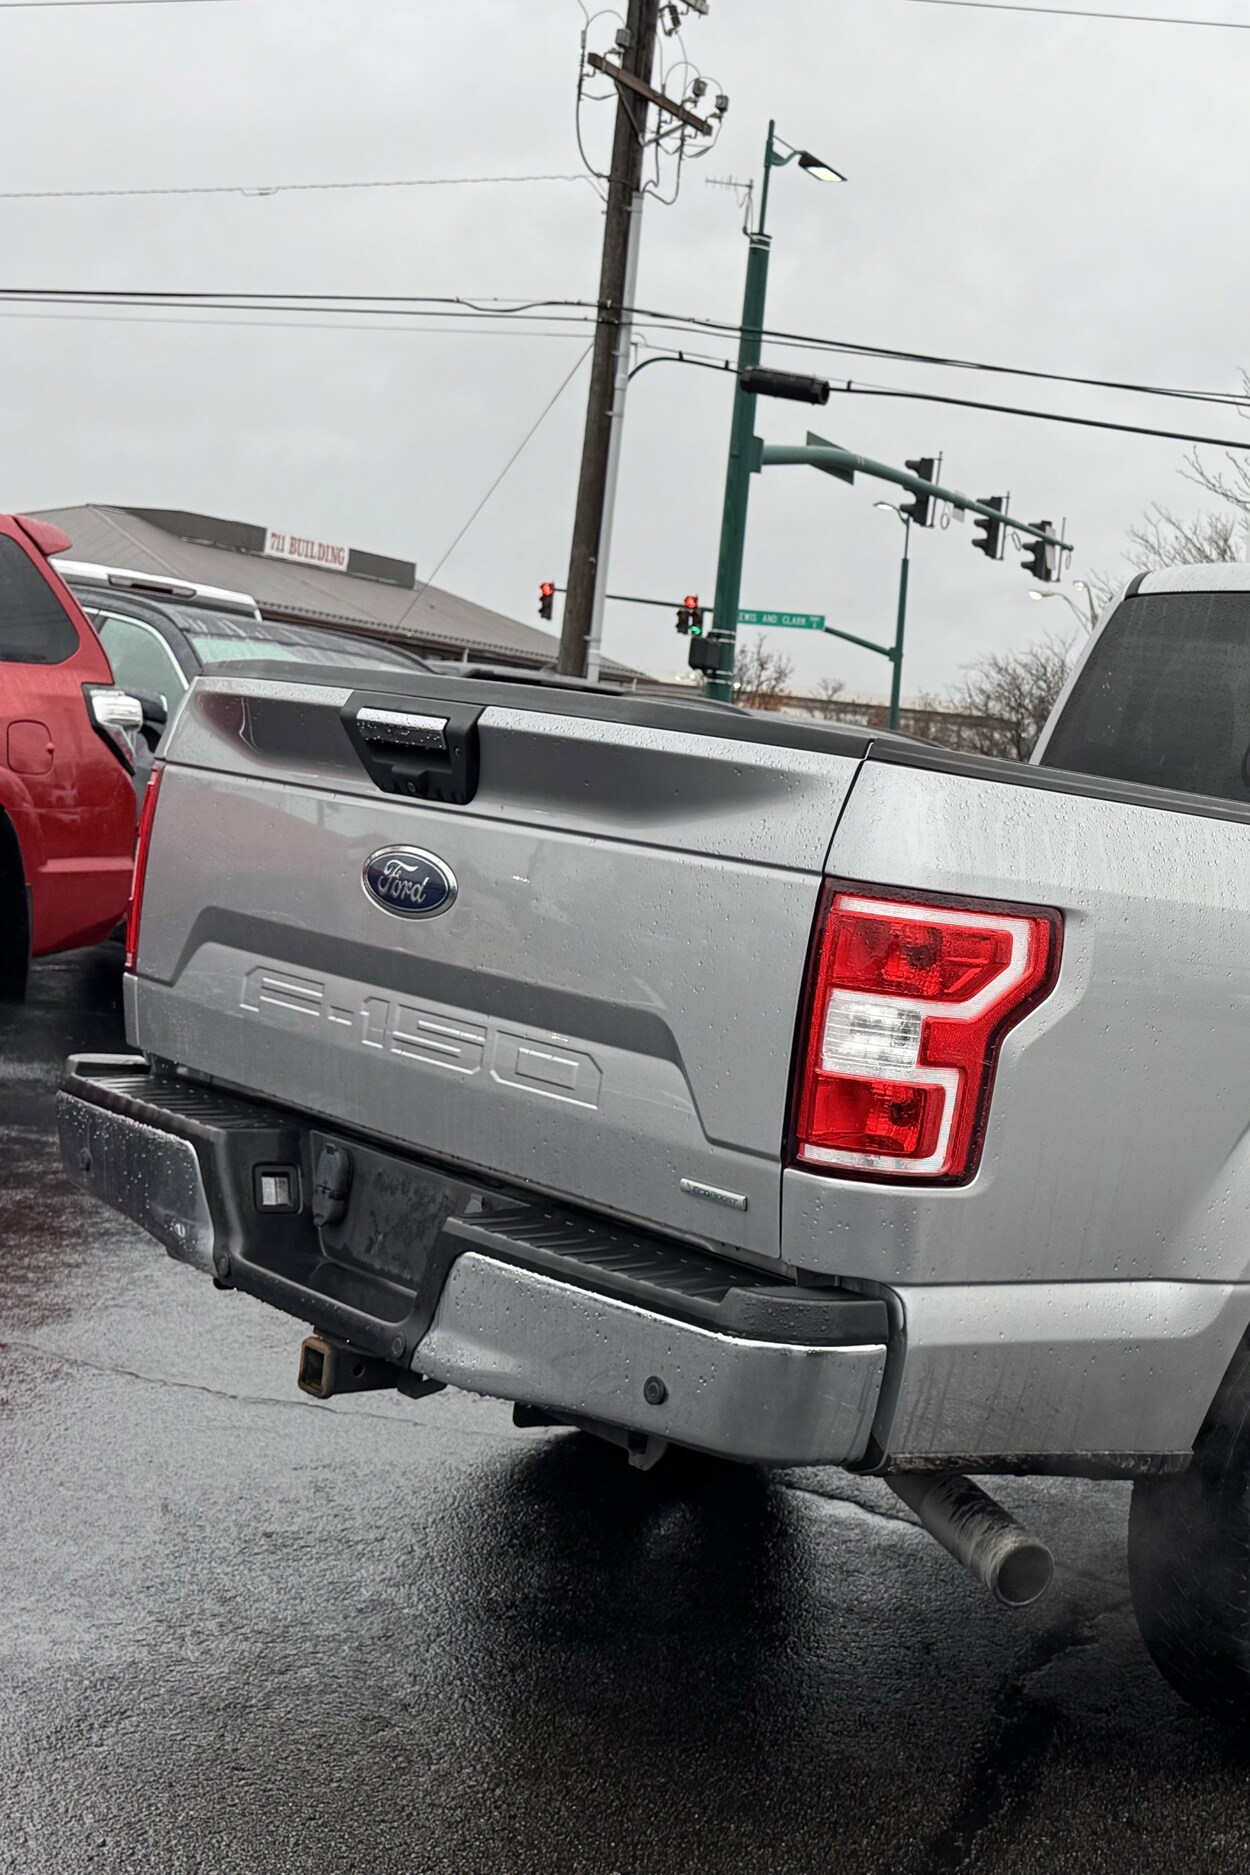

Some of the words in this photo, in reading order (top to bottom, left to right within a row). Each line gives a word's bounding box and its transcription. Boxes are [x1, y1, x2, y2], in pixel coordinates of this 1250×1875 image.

[271, 532, 286, 553] 711
[288, 535, 346, 566] BUILDING
[738, 612, 757, 622] EWIS
[762, 614, 777, 624] AND
[782, 615, 806, 625] CLARK
[377, 859, 430, 903] Ford
[239, 965, 604, 1110] F-150
